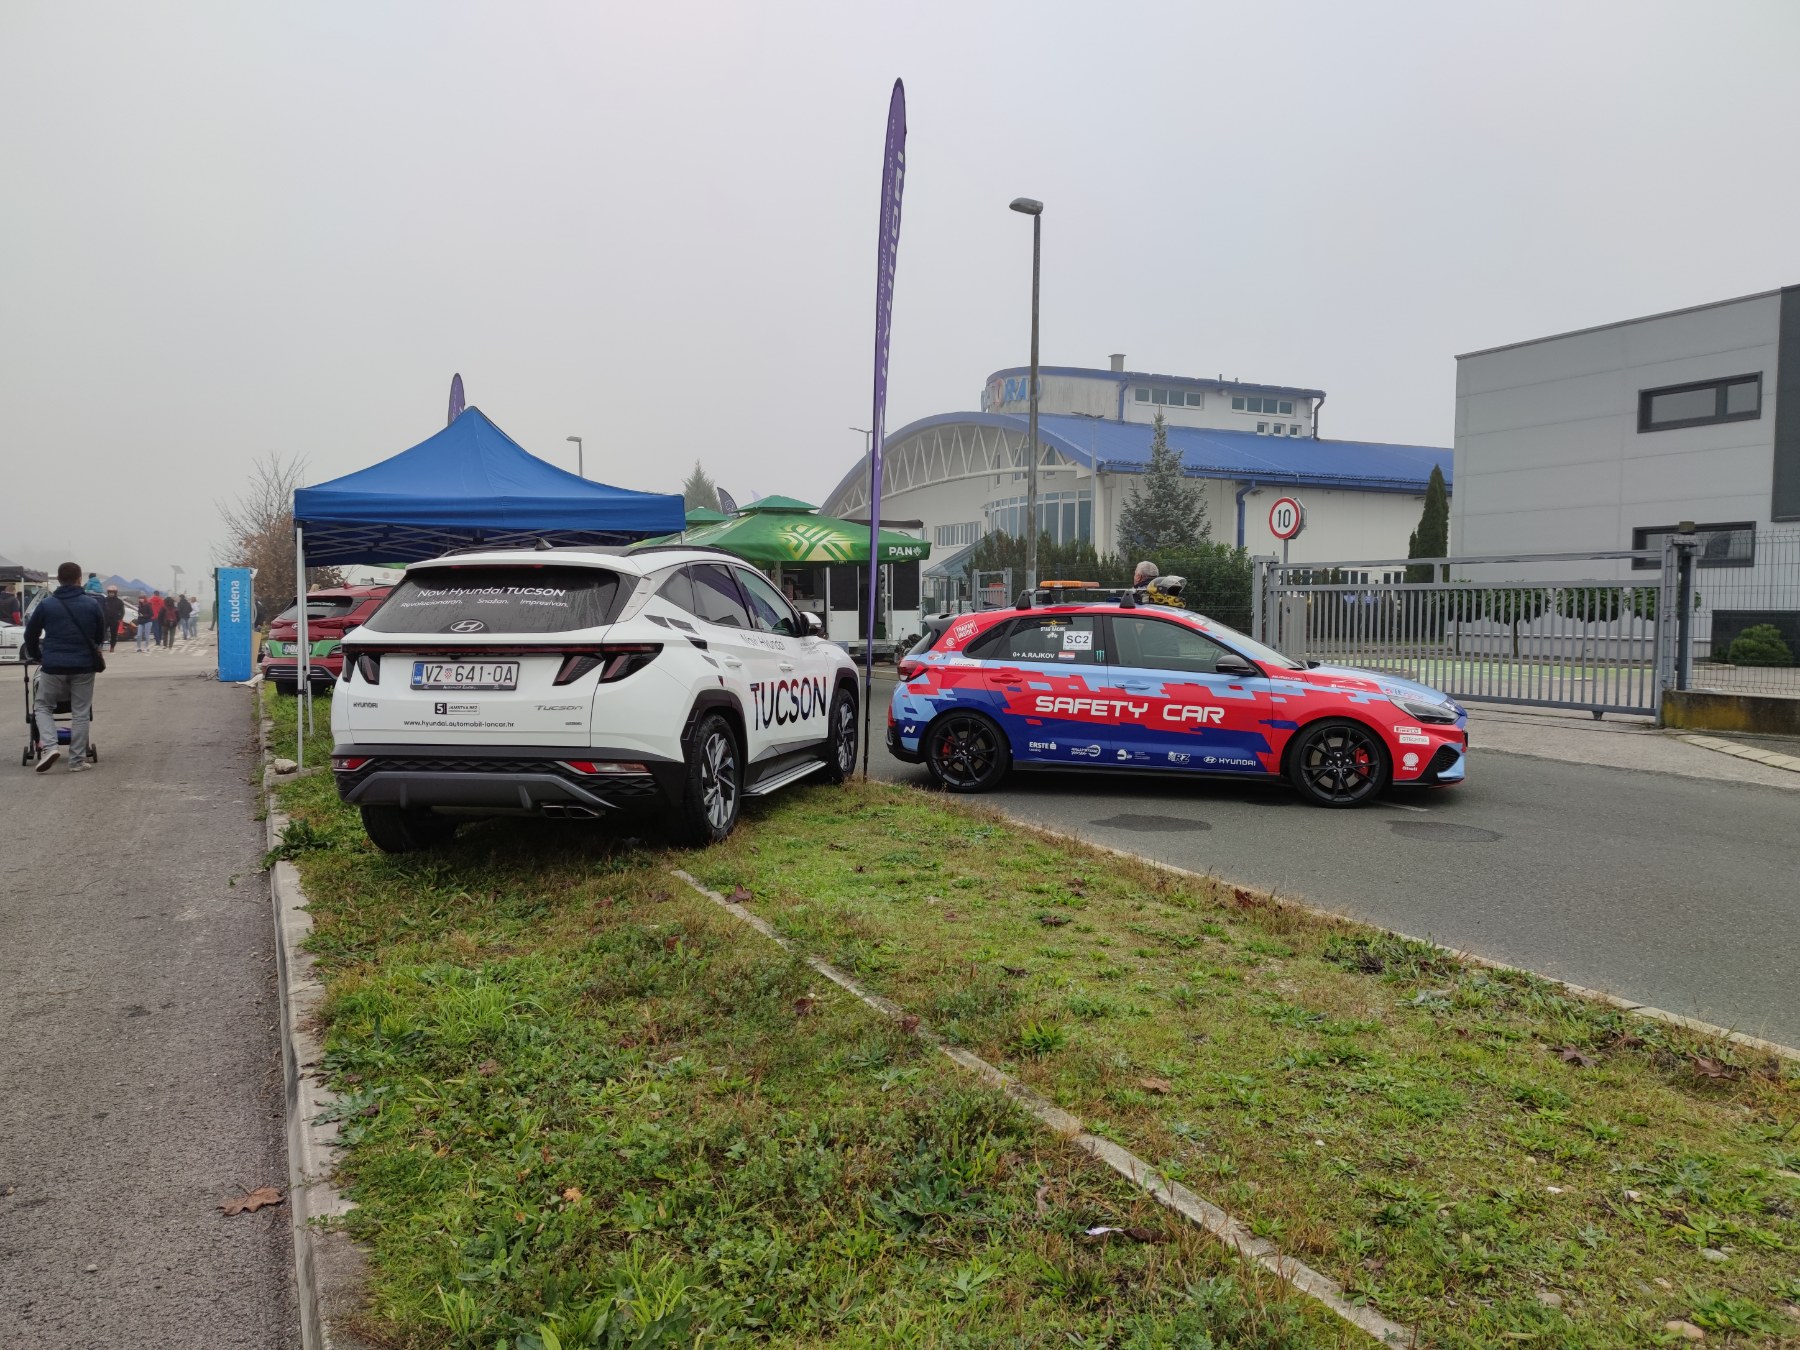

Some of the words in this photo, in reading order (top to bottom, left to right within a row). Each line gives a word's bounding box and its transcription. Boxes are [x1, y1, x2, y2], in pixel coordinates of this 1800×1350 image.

[1278, 508, 1291, 528] 10
[888, 546, 913, 556] PAN
[417, 589, 447, 597] Novi
[449, 587, 506, 596] Hyundai
[506, 587, 567, 597] TUCSON
[229, 580, 240, 623] studena
[1066, 635, 1089, 644] SC2
[436, 703, 444, 714] 5
[750, 677, 827, 731] TUCSON
[1035, 695, 1149, 719] SAFETY
[1162, 704, 1225, 724] CAR
[1029, 741, 1049, 750] ERSTE
[1218, 757, 1257, 767] HYUNDAI
